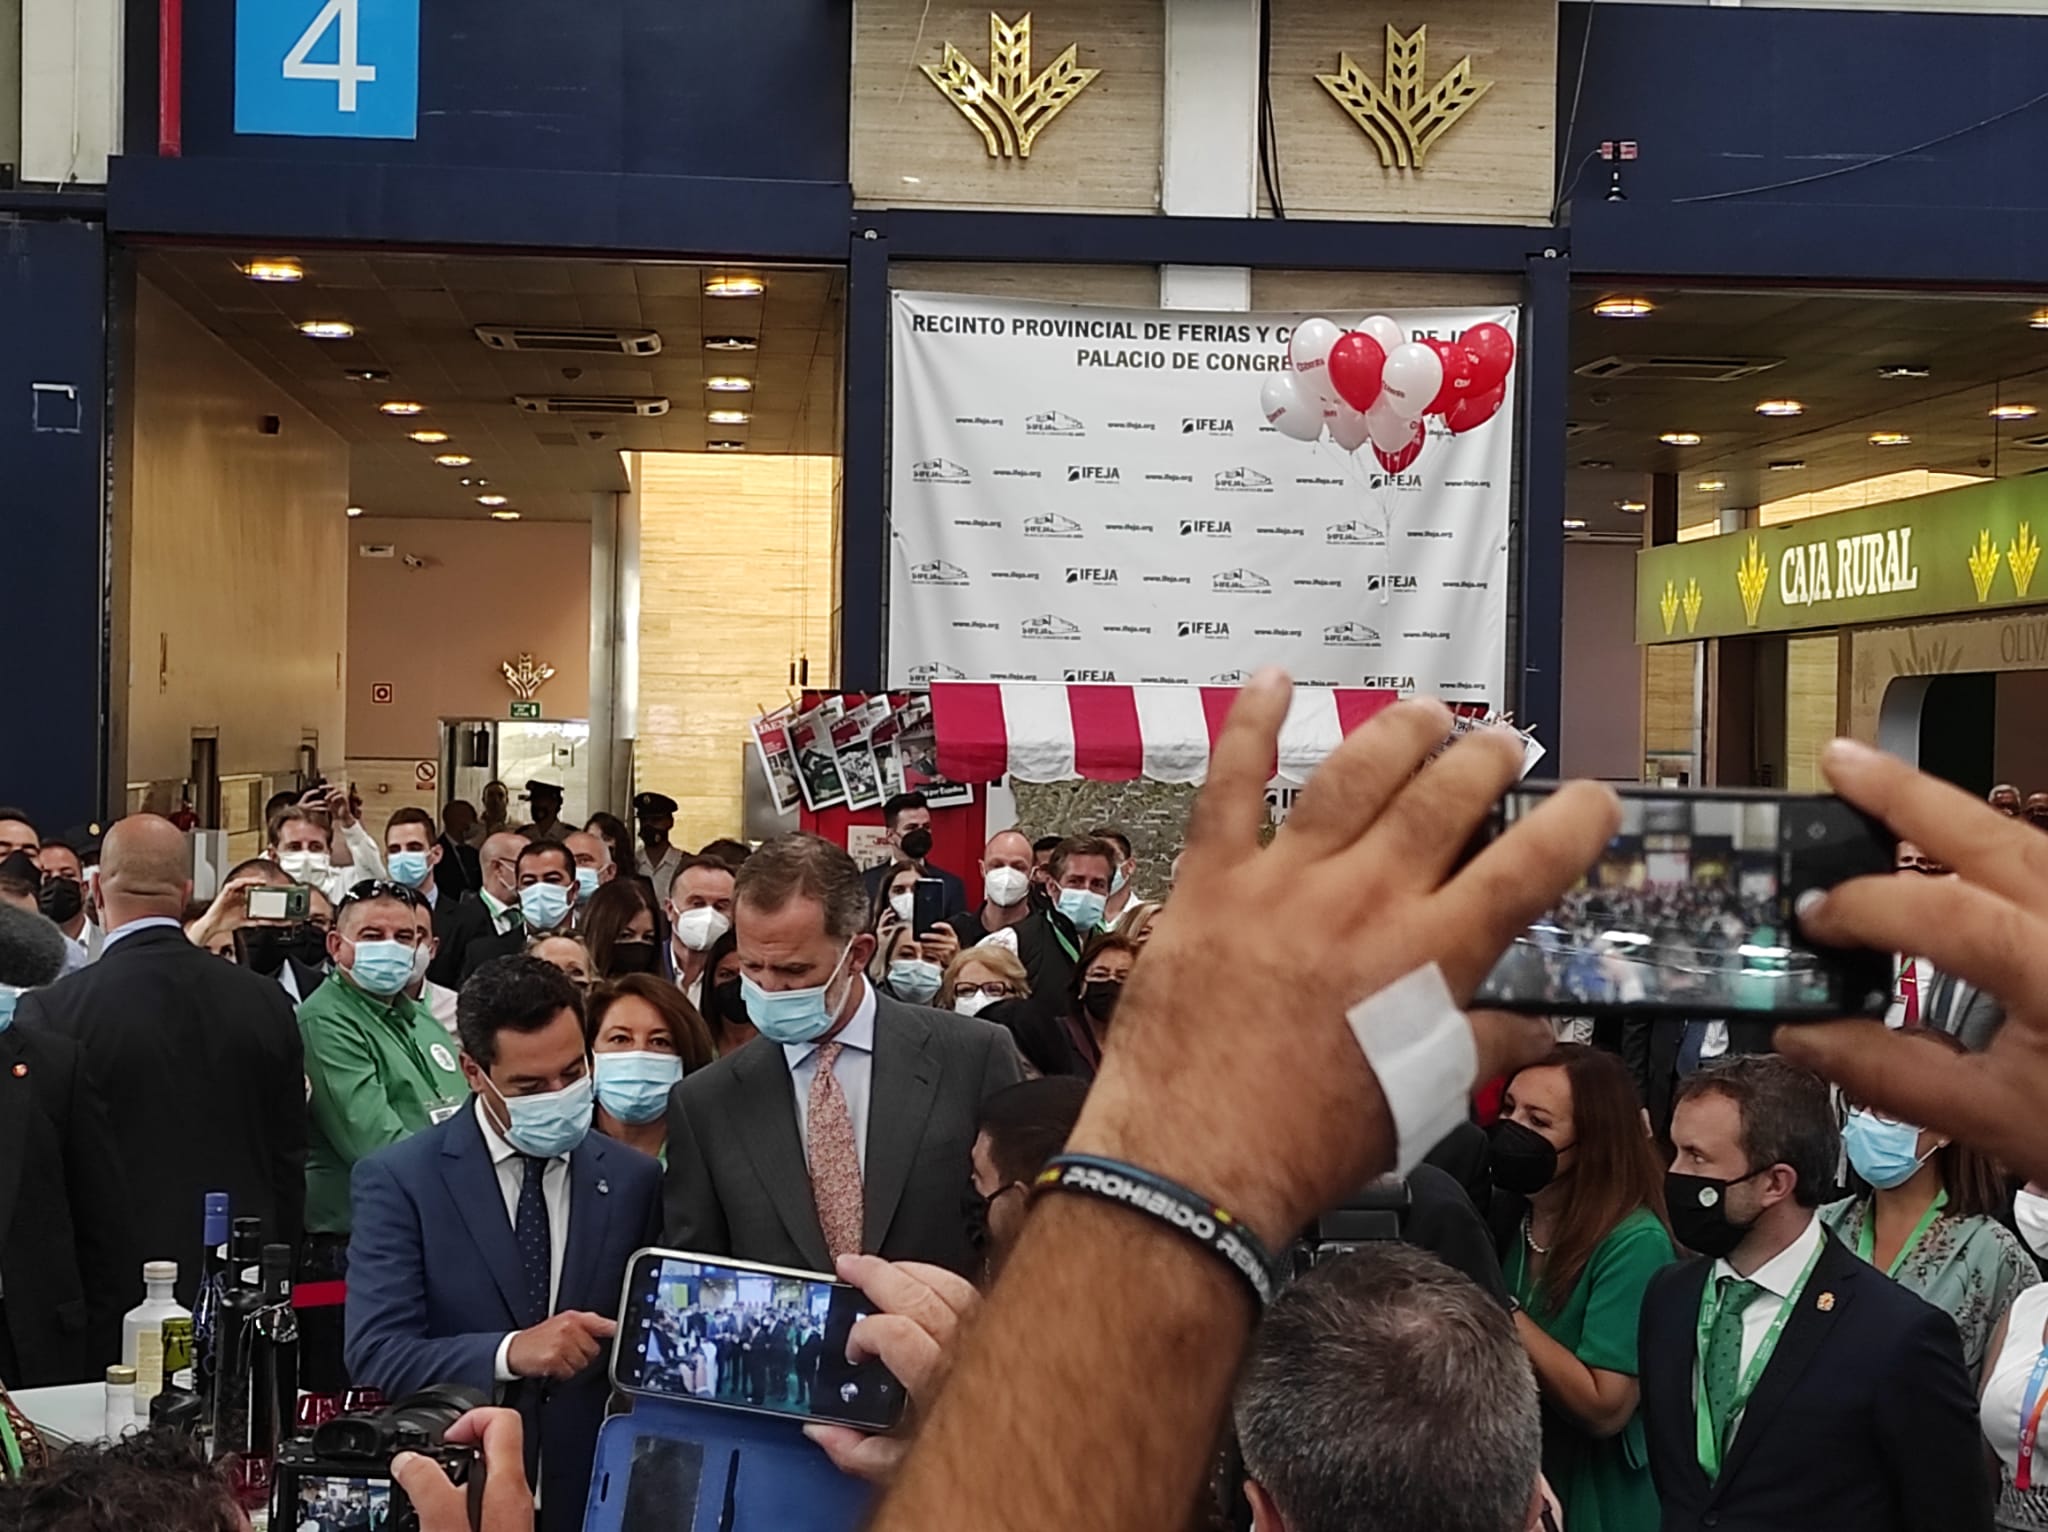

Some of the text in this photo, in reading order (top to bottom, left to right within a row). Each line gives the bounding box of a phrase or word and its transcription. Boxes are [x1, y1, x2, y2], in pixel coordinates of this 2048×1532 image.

[283, 0, 376, 112] 4
[912, 315, 1005, 335] RECINTO
[1012, 319, 1138, 340] PROVINCIAL
[1144, 323, 1171, 340] DE
[1178, 324, 1250, 343] FERIAS
[1256, 326, 1270, 343] Y
[1077, 349, 1165, 369] PALACIO
[1172, 352, 1200, 370] DE
[1207, 354, 1291, 372] CONGRE
[1196, 419, 1233, 431] IFEJA
[1082, 467, 1119, 479] IFEJA
[1384, 474, 1421, 487] IFEJA
[1194, 521, 1231, 534] IFEJA
[1780, 527, 1918, 607] CAJA RURAL
[1080, 569, 1117, 580] IFEJA
[1382, 576, 1417, 588] IFEJA
[1192, 622, 1229, 634] IFEJA
[1078, 670, 1116, 682] IFEJA
[1378, 677, 1415, 688] IFEJA
[1062, 1166, 1216, 1240] PROHIBIDO
